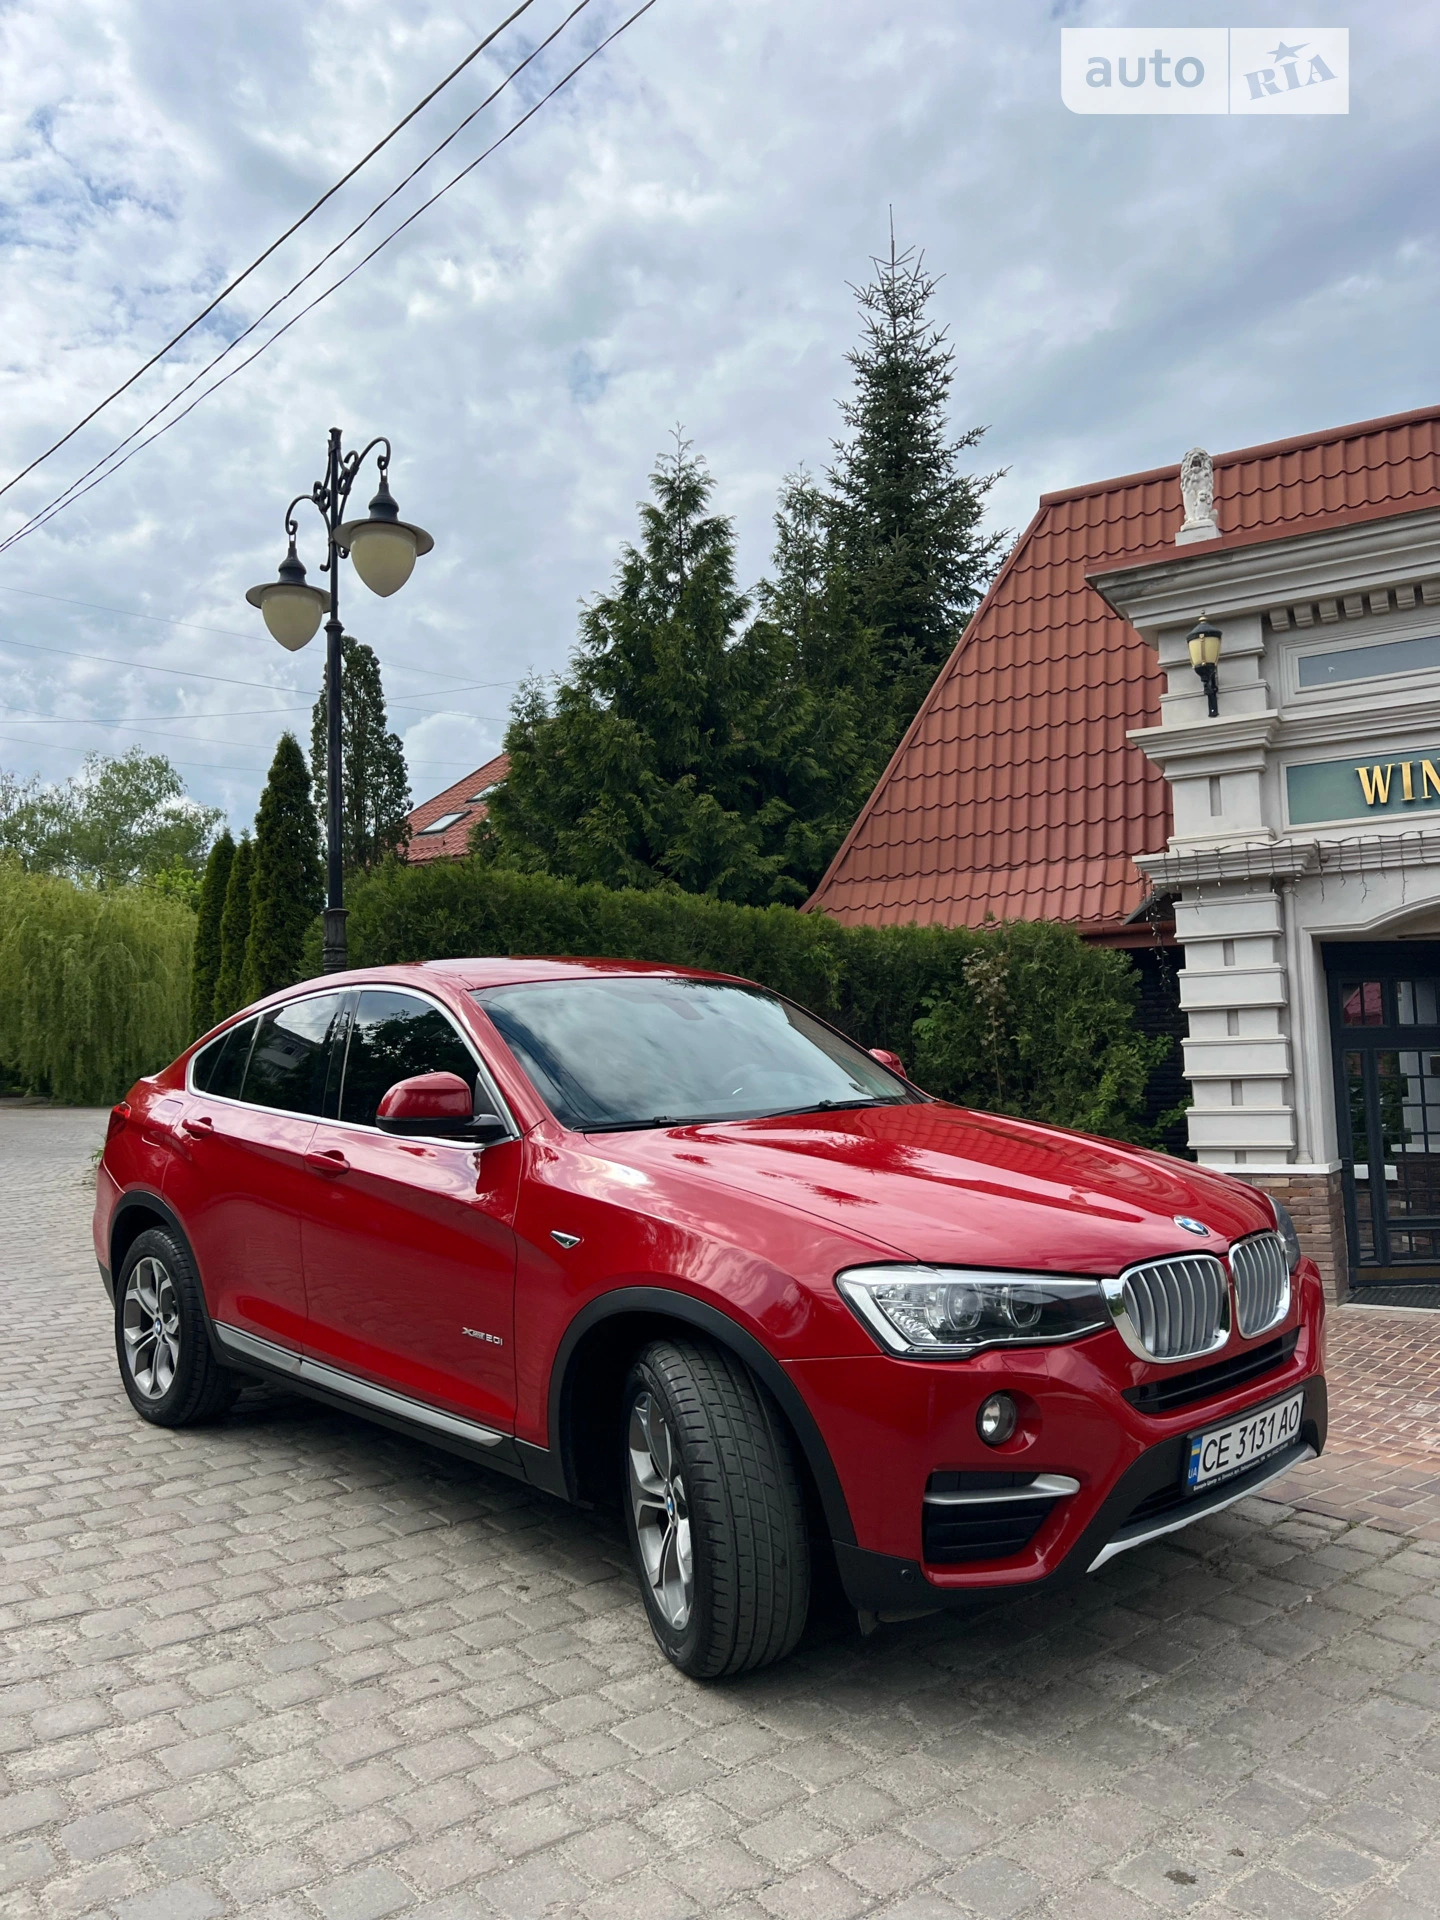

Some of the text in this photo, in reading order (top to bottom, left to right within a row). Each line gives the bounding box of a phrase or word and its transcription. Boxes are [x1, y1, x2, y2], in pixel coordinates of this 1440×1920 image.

[1202, 1432, 1232, 1473] CE
[1236, 1412, 1276, 1460] 3131
[1277, 1400, 1300, 1440] AO
[1188, 1467, 1198, 1479] UA
